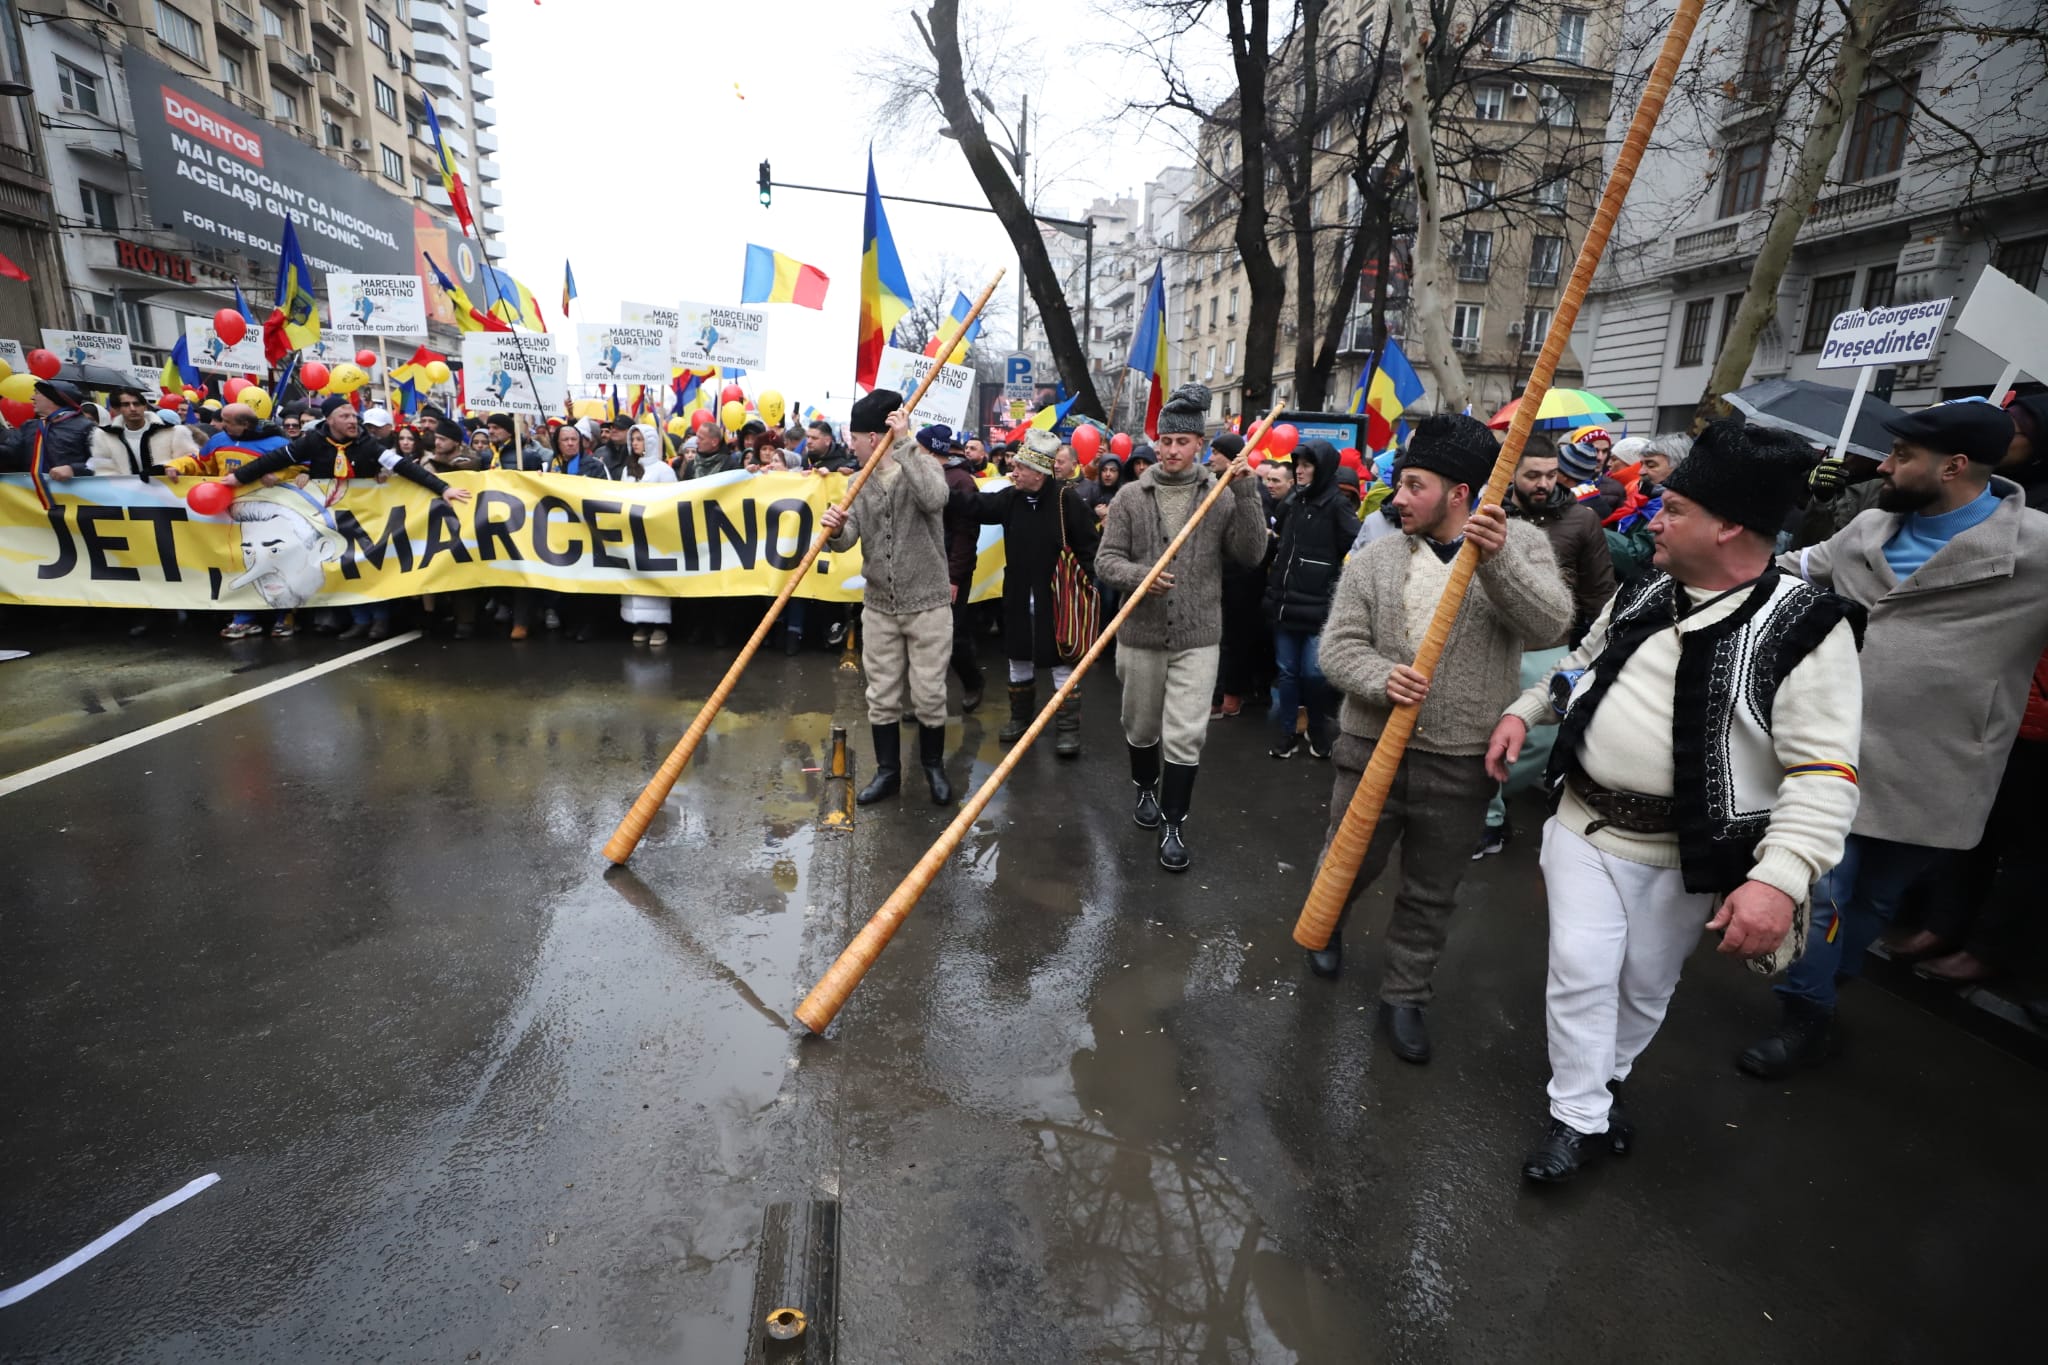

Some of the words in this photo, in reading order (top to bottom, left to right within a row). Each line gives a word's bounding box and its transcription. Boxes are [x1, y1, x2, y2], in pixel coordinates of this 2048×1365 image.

[165, 96, 261, 158] DORITOS
[171, 132, 214, 167] MAI
[216, 155, 304, 206] CROCANT
[308, 197, 329, 218] CA
[265, 197, 310, 228] GUST
[313, 217, 364, 250] ICONIC.
[183, 209, 216, 232] FOR
[217, 223, 246, 243] THE
[248, 234, 282, 256] BOLD
[117, 239, 197, 284] HOTEL
[361, 279, 416, 289] MARCELINO
[365, 288, 413, 298] BURATINO
[710, 309, 763, 323] MARCELINO
[1833, 311, 1866, 332] Călin
[1868, 302, 1947, 326] Georgescu
[396, 323, 419, 332] zbori!
[713, 317, 759, 332] BURATINO
[73, 334, 123, 345] MARCELINO
[609, 328, 663, 338] MARCELINO
[77, 341, 121, 350] BURATINO
[497, 337, 550, 347] MARCELINO
[613, 337, 661, 346] BURATINO
[1823, 326, 1937, 365] Președinte!
[500, 351, 557, 367] MARCELINO
[717, 355, 735, 364] cum
[736, 357, 759, 367] zbori!
[642, 373, 665, 382] zbori!
[1008, 358, 1031, 383] P
[512, 401, 532, 410] cum
[913, 409, 931, 419] cum
[933, 413, 956, 426] zbori!
[38, 504, 223, 600] JET,
